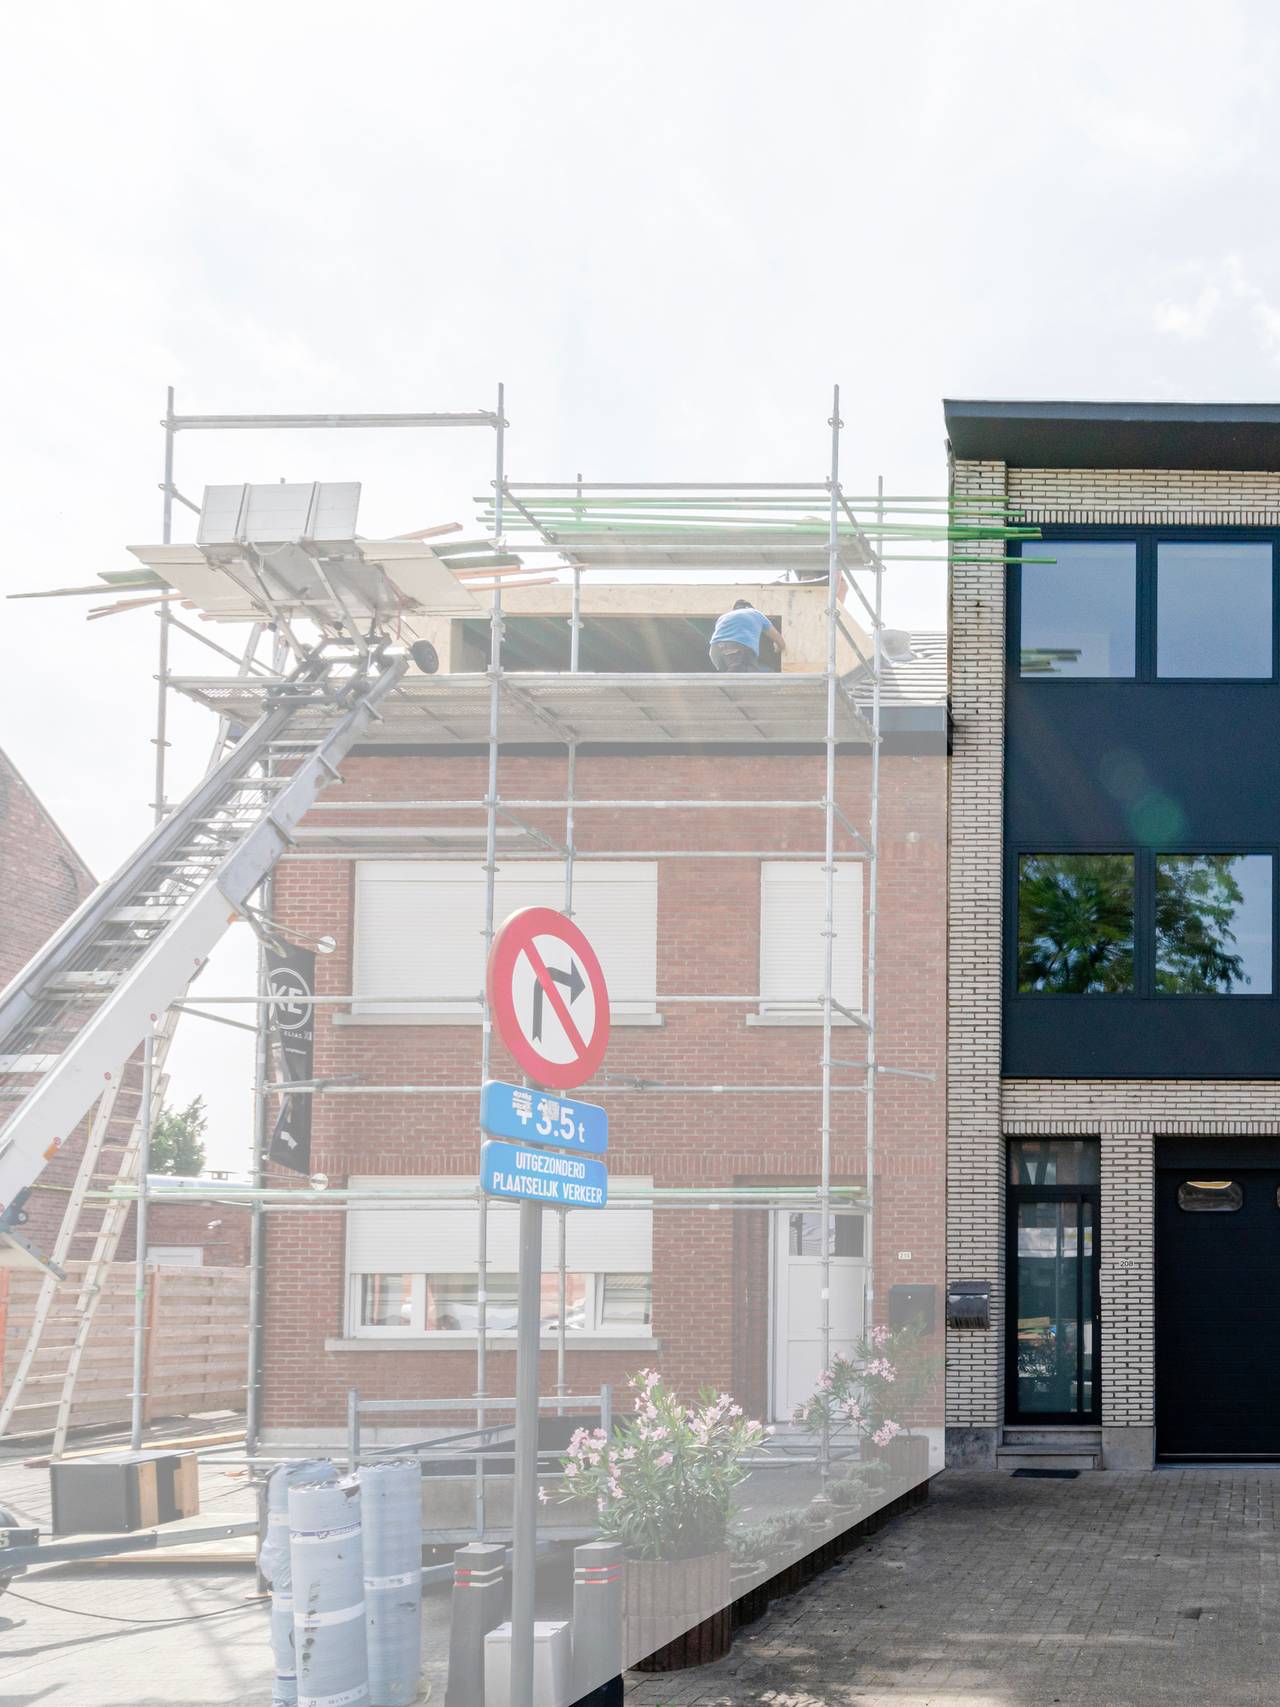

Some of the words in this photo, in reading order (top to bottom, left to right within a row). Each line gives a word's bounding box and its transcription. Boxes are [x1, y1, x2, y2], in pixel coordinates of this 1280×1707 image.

[577, 1122, 585, 1143] t
[516, 1151, 585, 1179] UITGEZONDERD
[493, 1172, 559, 1198] PLAATSELIJK
[563, 1183, 602, 1204] VERKEER
